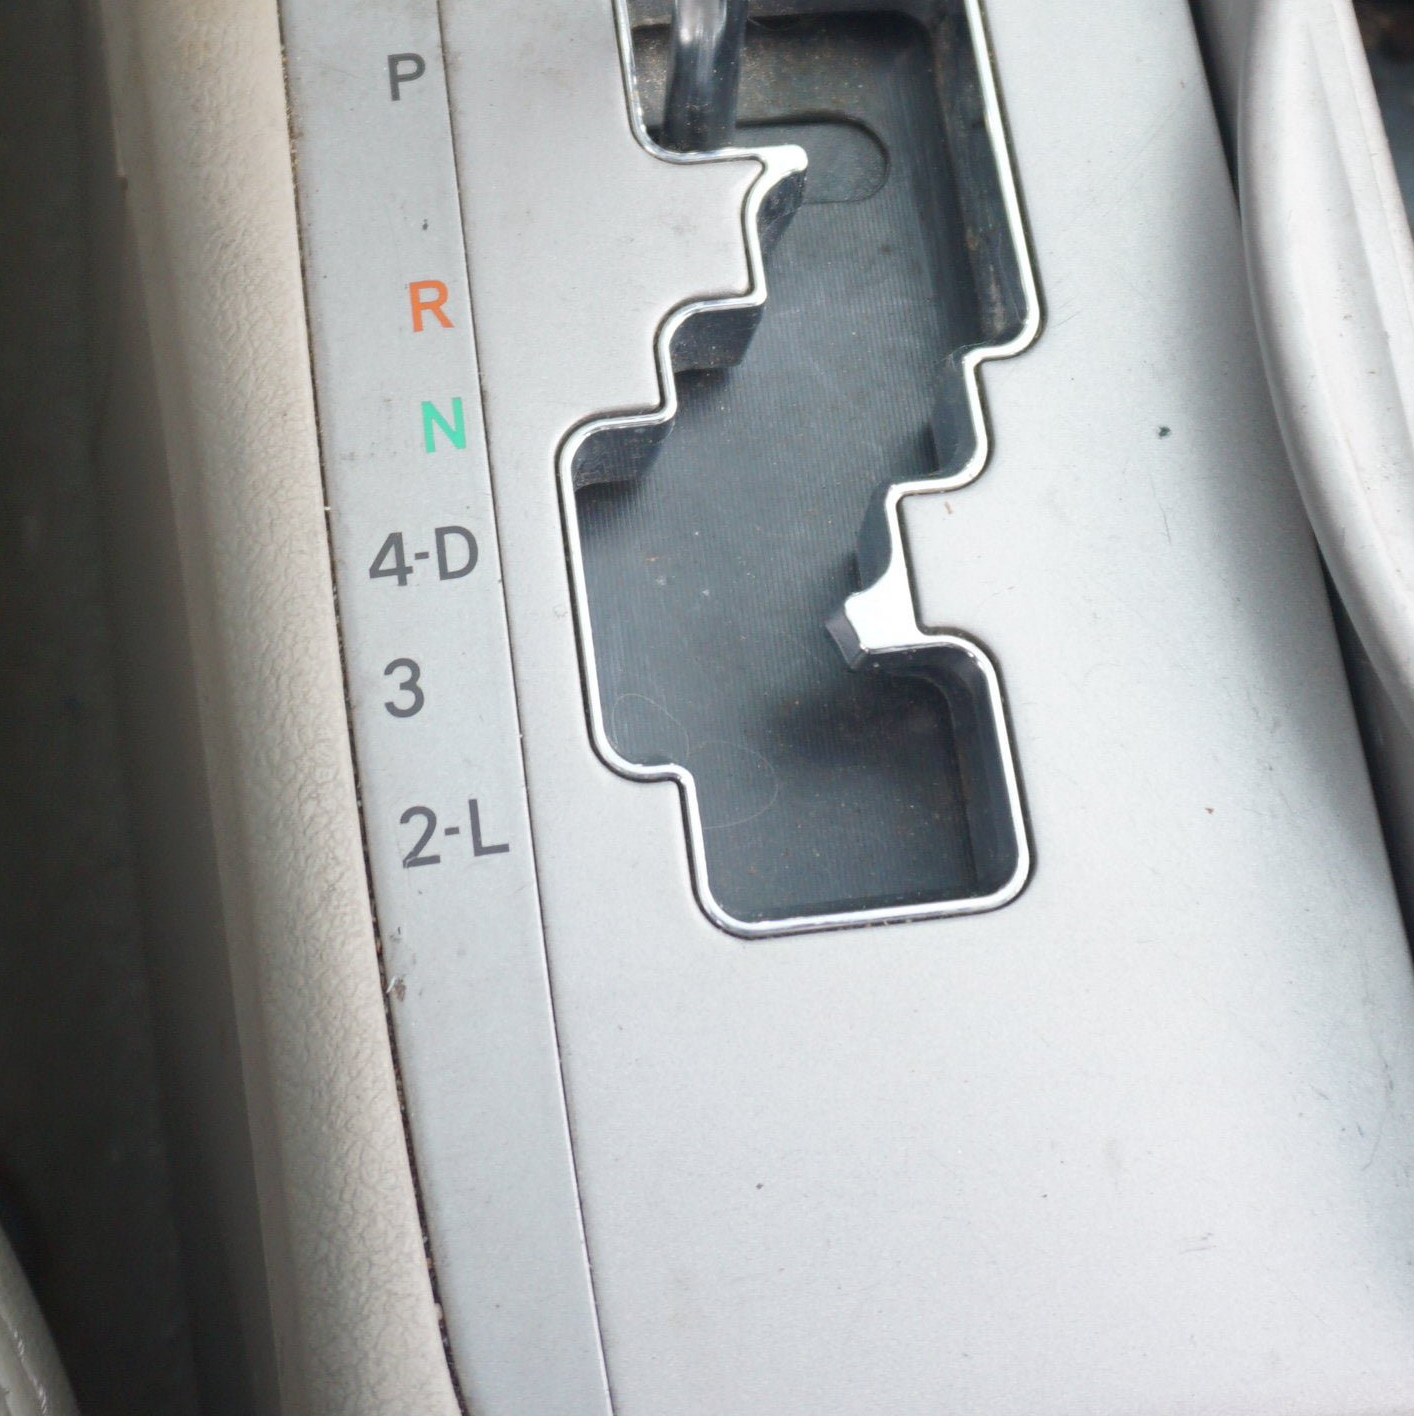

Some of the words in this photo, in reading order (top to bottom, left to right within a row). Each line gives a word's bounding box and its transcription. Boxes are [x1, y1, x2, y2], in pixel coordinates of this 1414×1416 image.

[387, 52, 426, 102] P
[408, 279, 454, 333] R
[420, 396, 467, 454] N
[368, 525, 479, 587] 4-D
[383, 657, 425, 719] 3
[399, 798, 511, 870] 2-L
